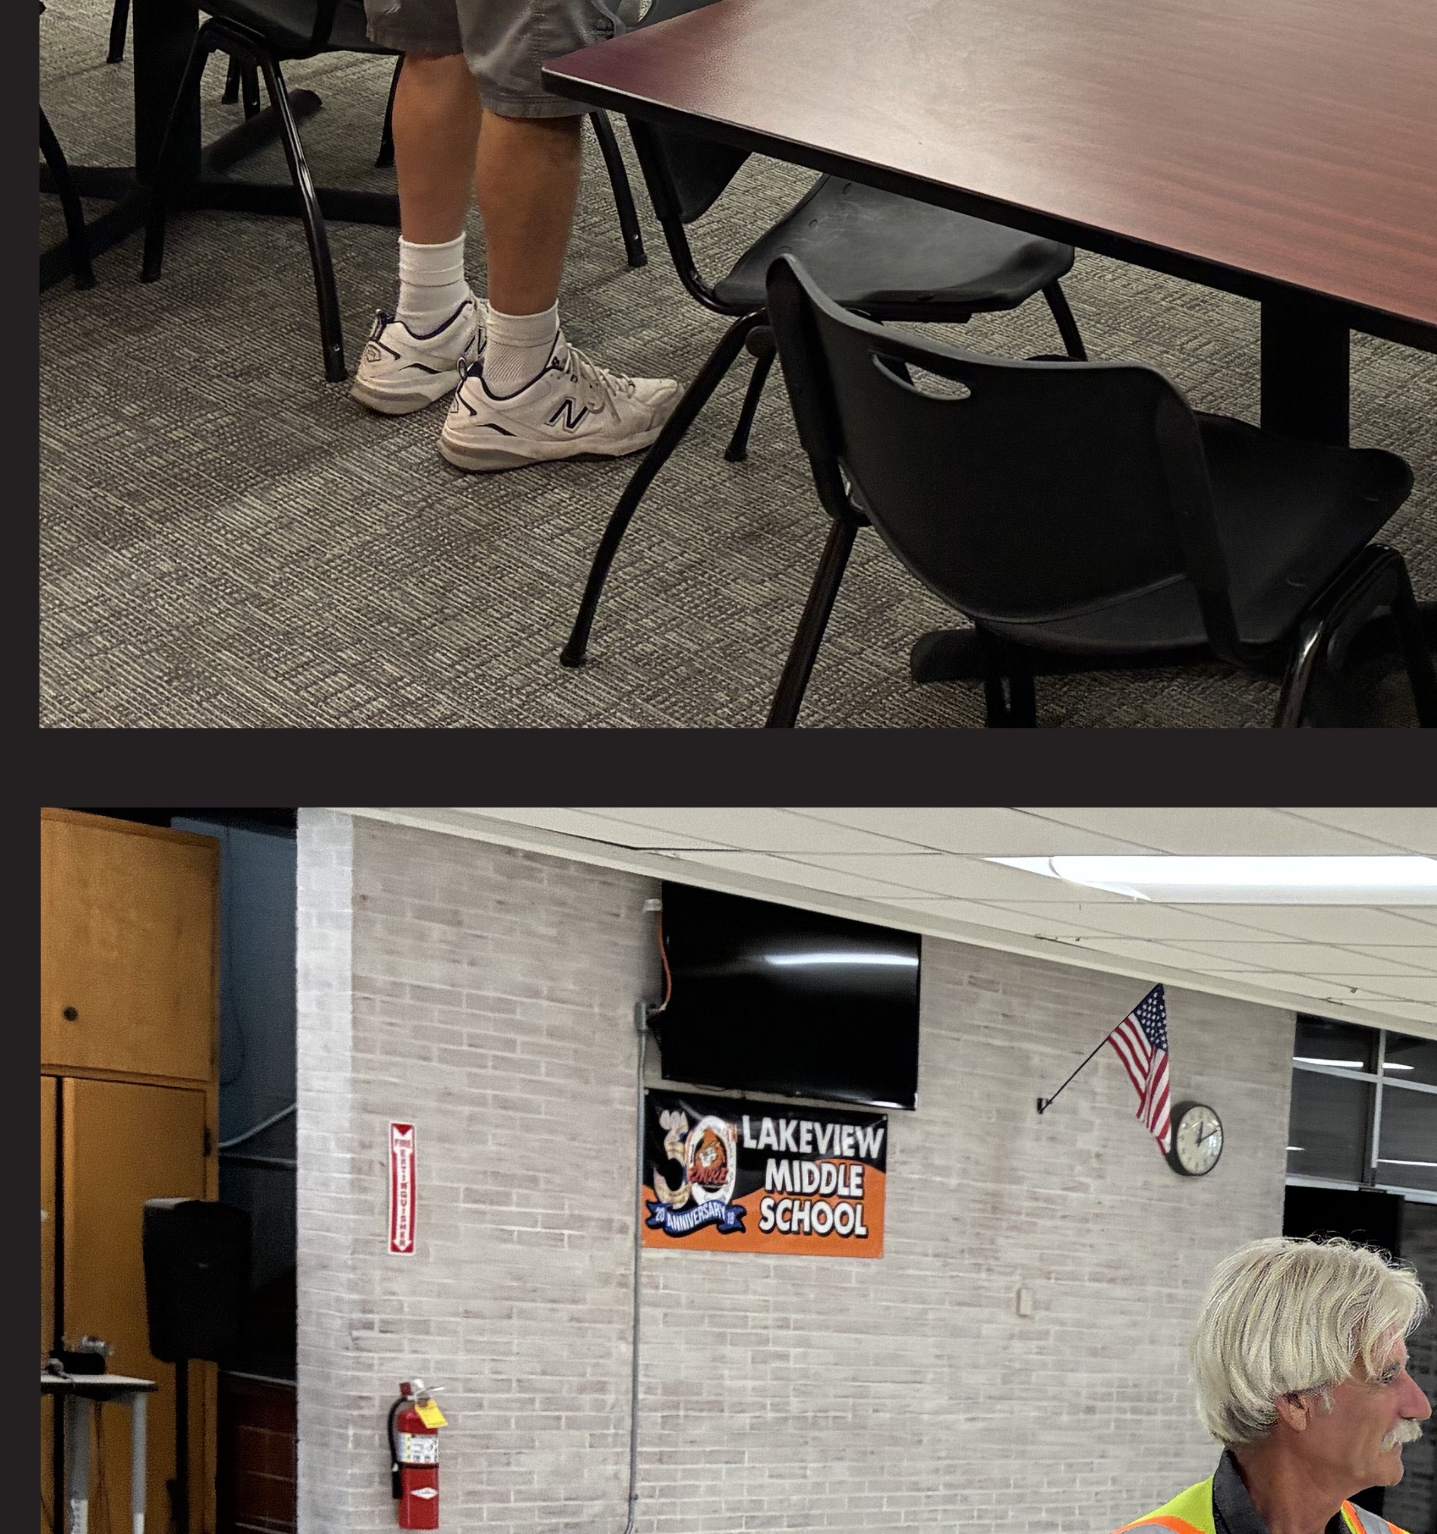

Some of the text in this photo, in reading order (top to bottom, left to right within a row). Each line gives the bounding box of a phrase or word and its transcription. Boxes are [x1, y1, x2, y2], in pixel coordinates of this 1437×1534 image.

[741, 1114, 885, 1159] LAKEVIEW
[764, 1158, 864, 1197] MIDDLE
[667, 1200, 726, 1233] ANNIVERSARY
[758, 1196, 868, 1236] SCHOOL
